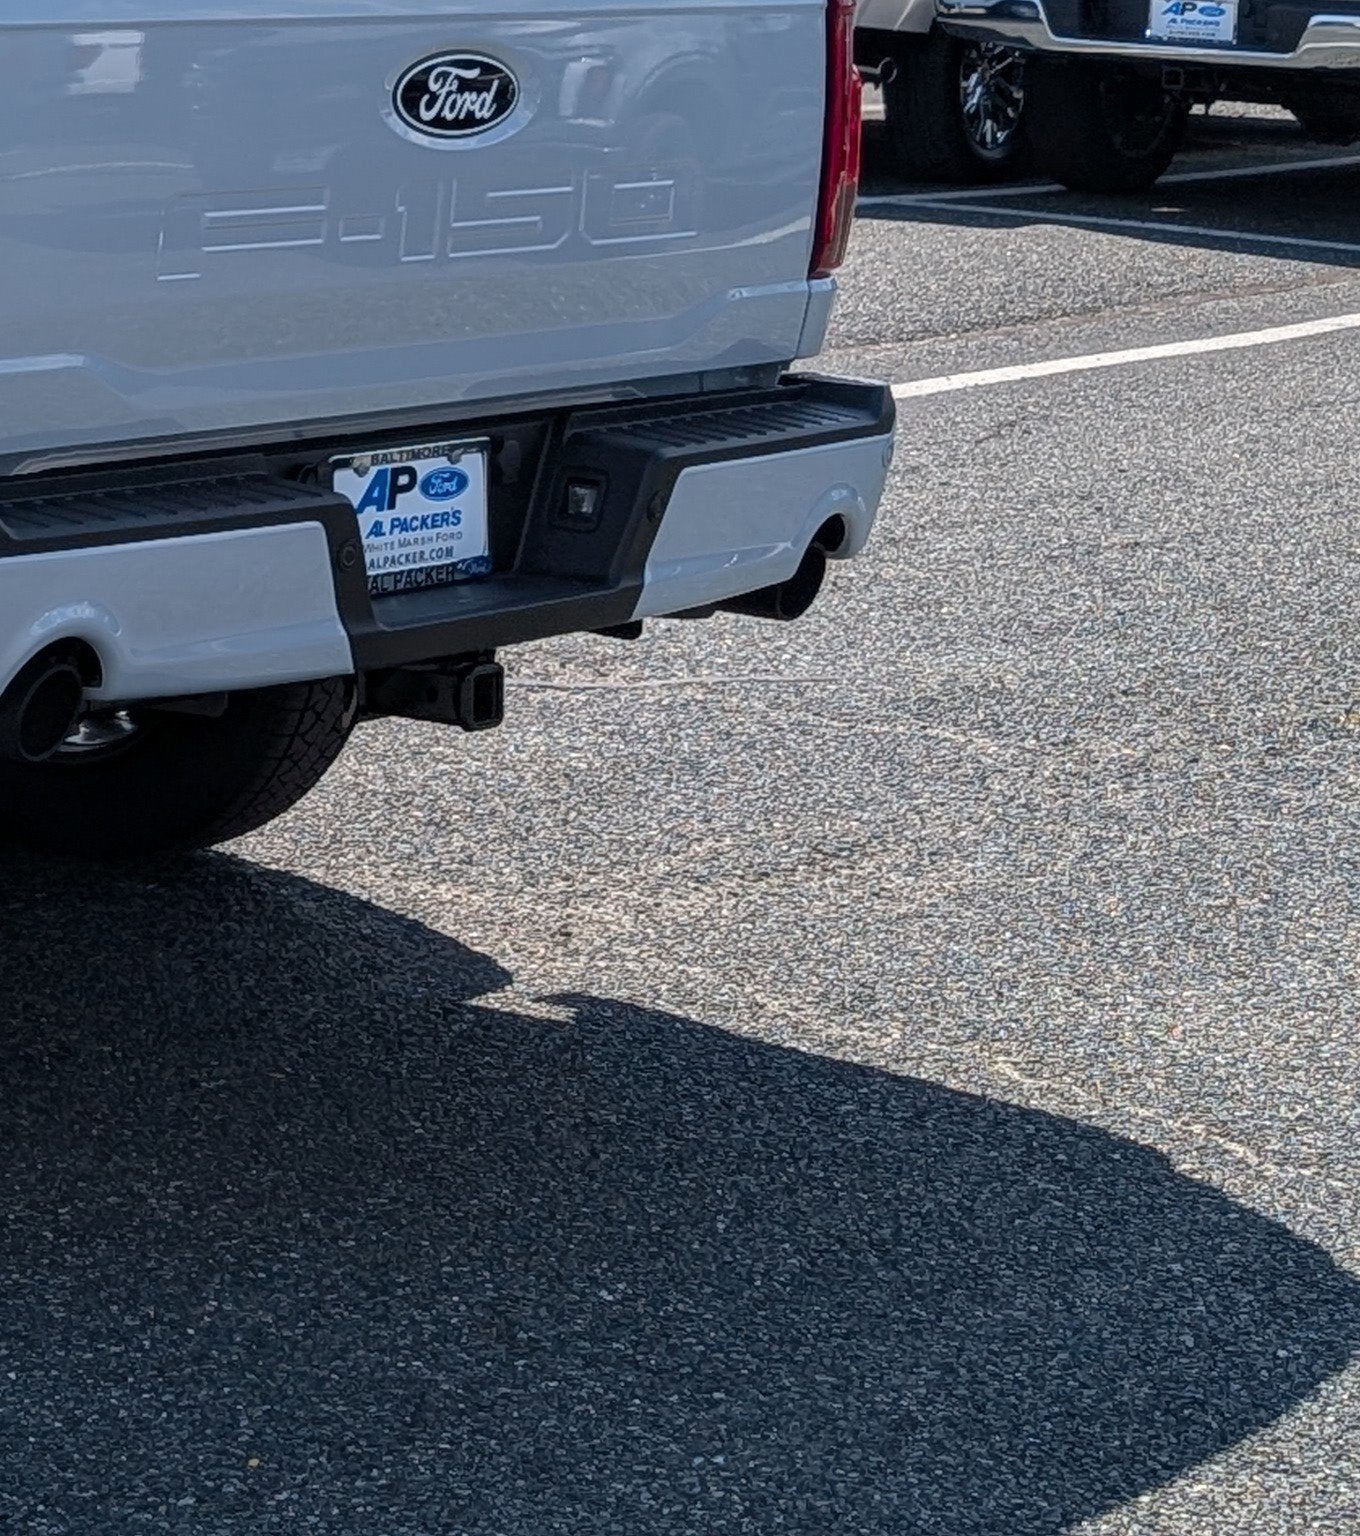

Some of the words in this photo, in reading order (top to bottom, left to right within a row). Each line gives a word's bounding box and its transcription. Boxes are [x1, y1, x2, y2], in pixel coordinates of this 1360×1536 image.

[418, 64, 498, 121] Ford
[156, 168, 699, 281] F-150
[371, 445, 450, 465] BALTIMORE
[356, 465, 418, 514] AP
[365, 519, 386, 540] AL
[389, 508, 462, 536] PACKER'S
[398, 534, 434, 548] MARSH
[436, 531, 463, 543] FORD
[368, 546, 455, 570] ALPACKER.COM
[393, 565, 455, 589] PACKER
